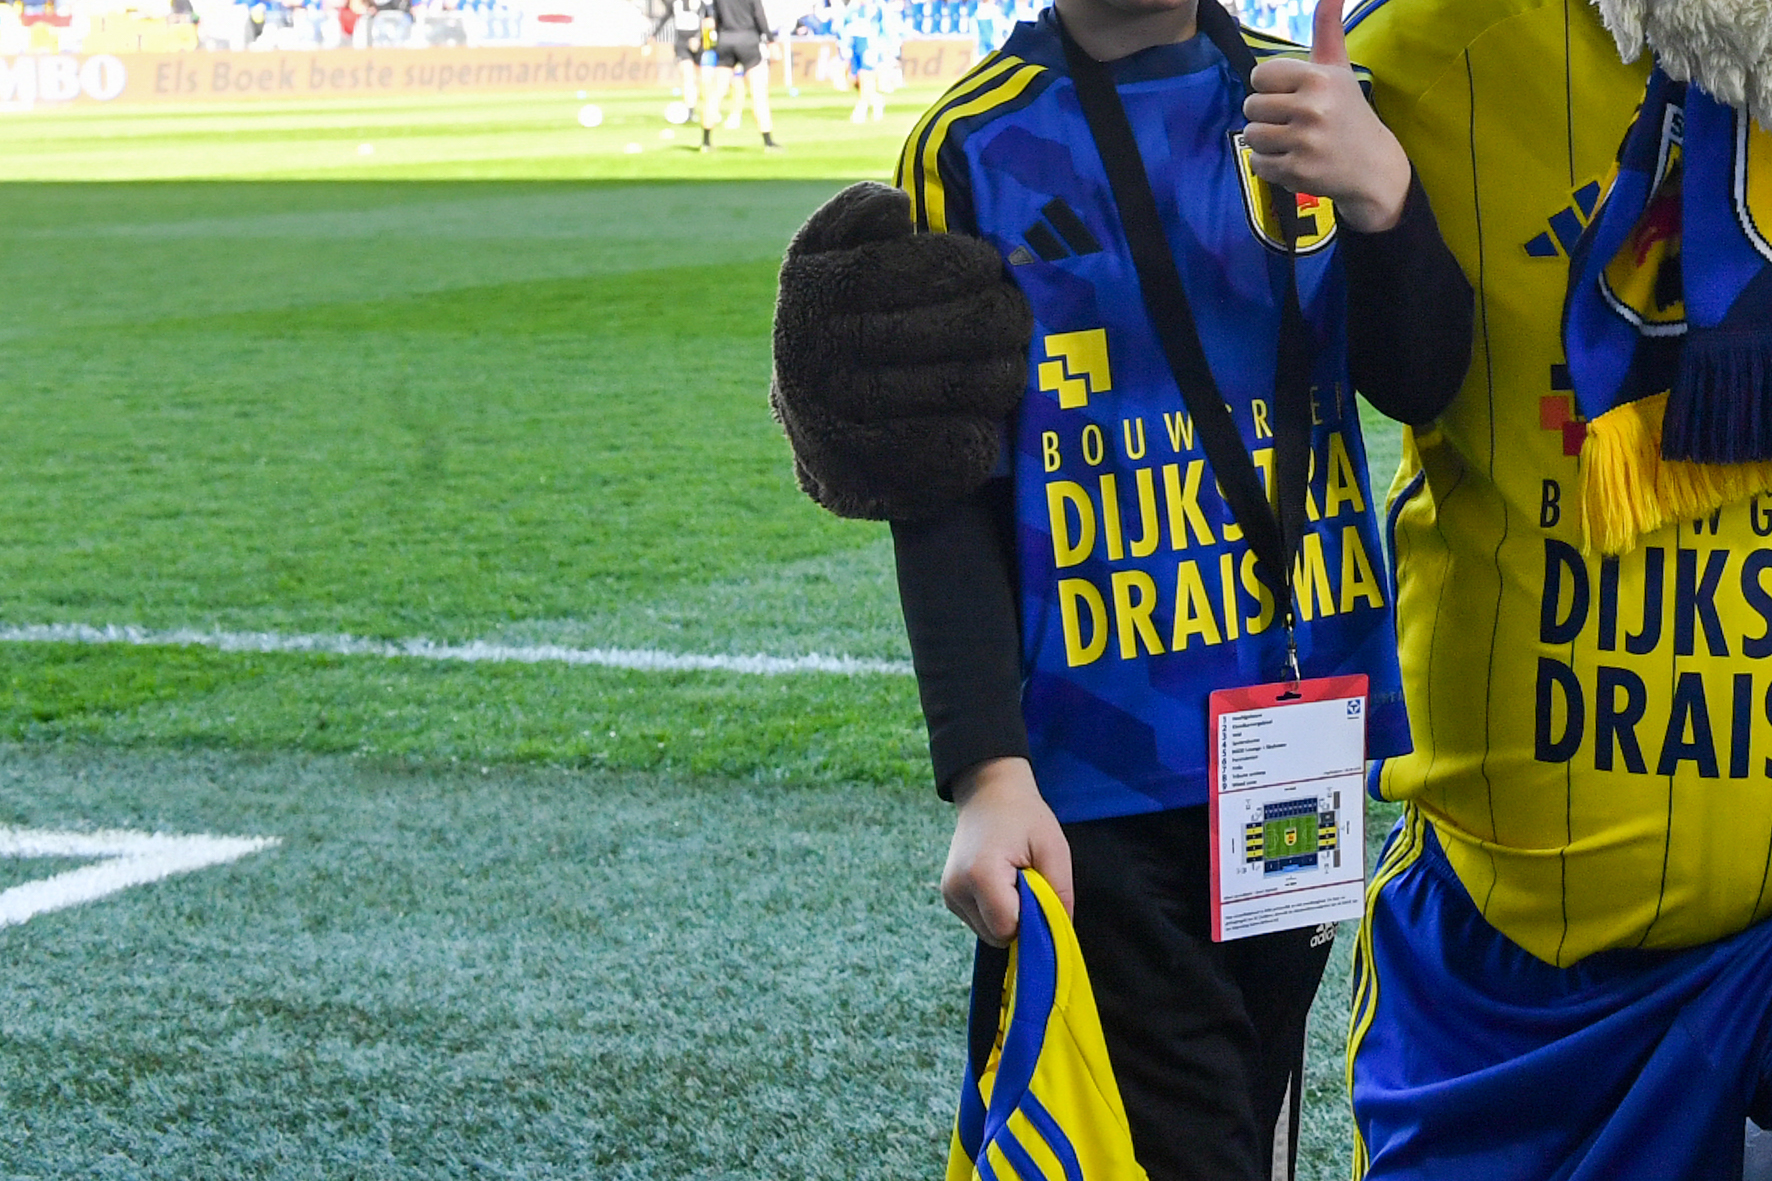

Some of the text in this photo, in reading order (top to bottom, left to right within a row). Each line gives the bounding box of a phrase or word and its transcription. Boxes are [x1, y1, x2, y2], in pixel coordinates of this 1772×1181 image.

[153, 59, 198, 94] Els
[210, 57, 295, 93] Boek
[308, 54, 394, 90] beste
